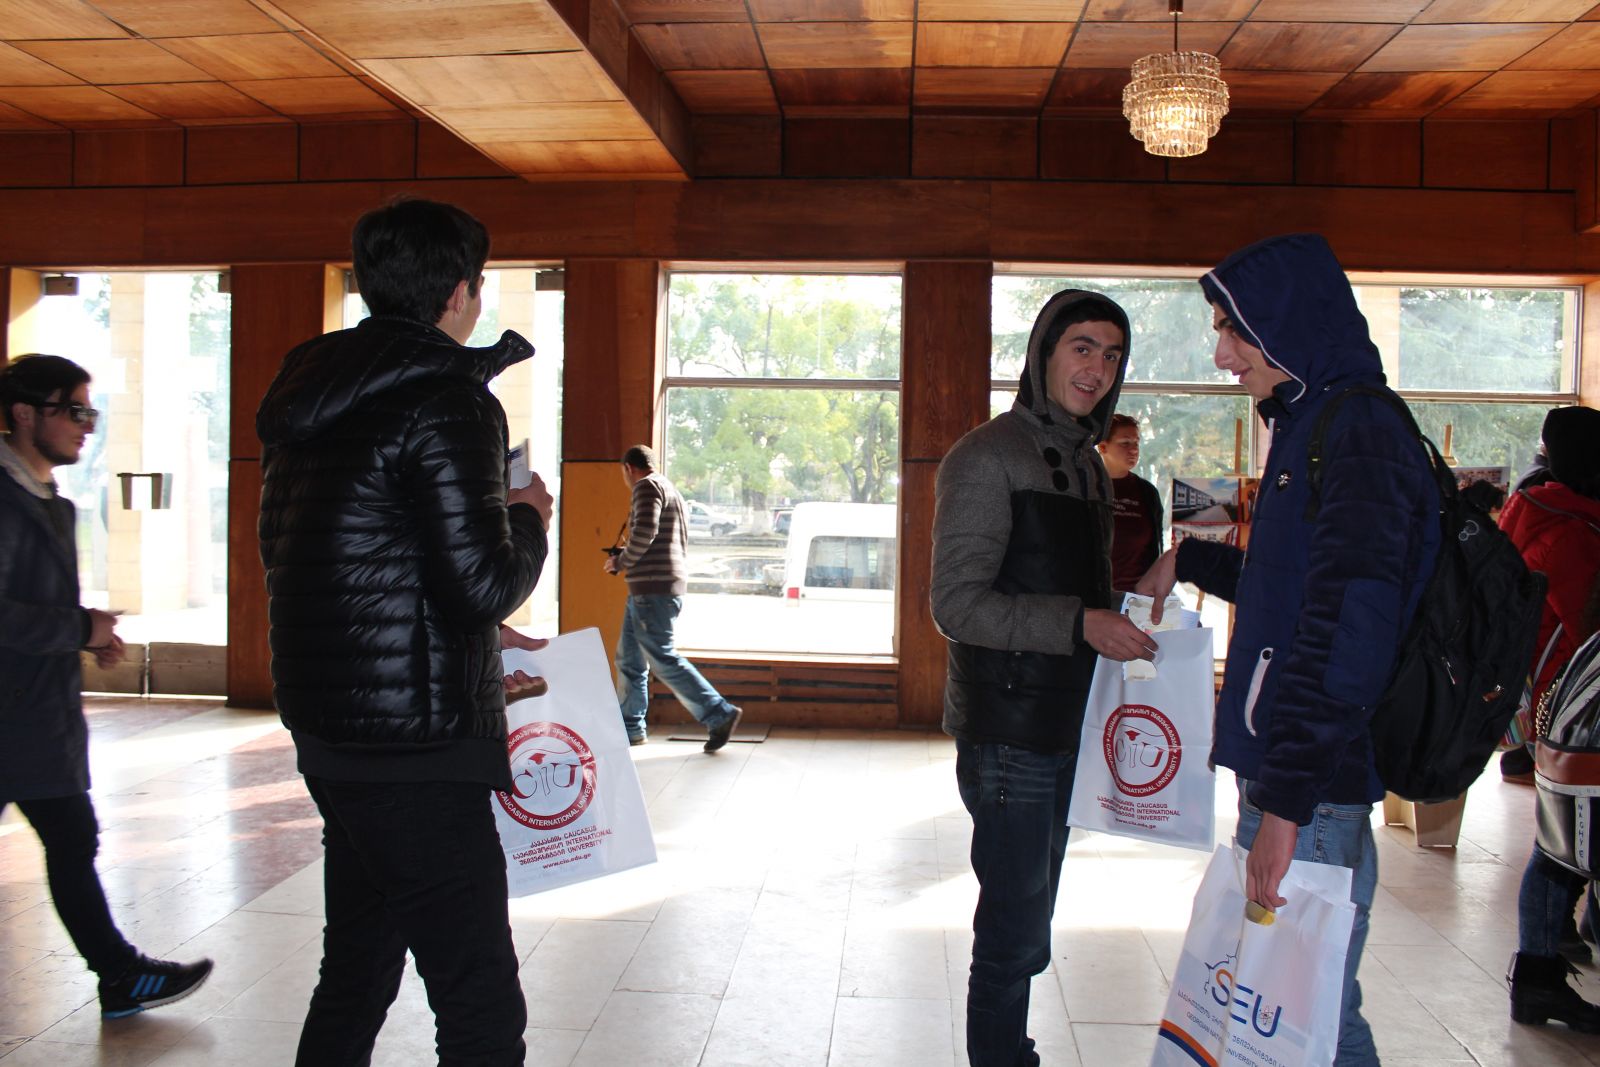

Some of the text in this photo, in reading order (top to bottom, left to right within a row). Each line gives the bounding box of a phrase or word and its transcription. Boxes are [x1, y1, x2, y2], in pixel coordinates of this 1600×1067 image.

[1156, 755, 1178, 787] UNIVERSITY
[499, 791, 528, 822] CAUCASUS
[528, 808, 580, 826] INTERNATIONAL
[1136, 808, 1181, 816] INTERNATIONAL
[563, 825, 597, 839] CAUCASUS
[565, 828, 613, 847] INTERNATIONAL
[567, 839, 603, 853] UNIVERSITY
[1211, 968, 1283, 1039] SEU
[1186, 1010, 1210, 1033] GEORGIAN
